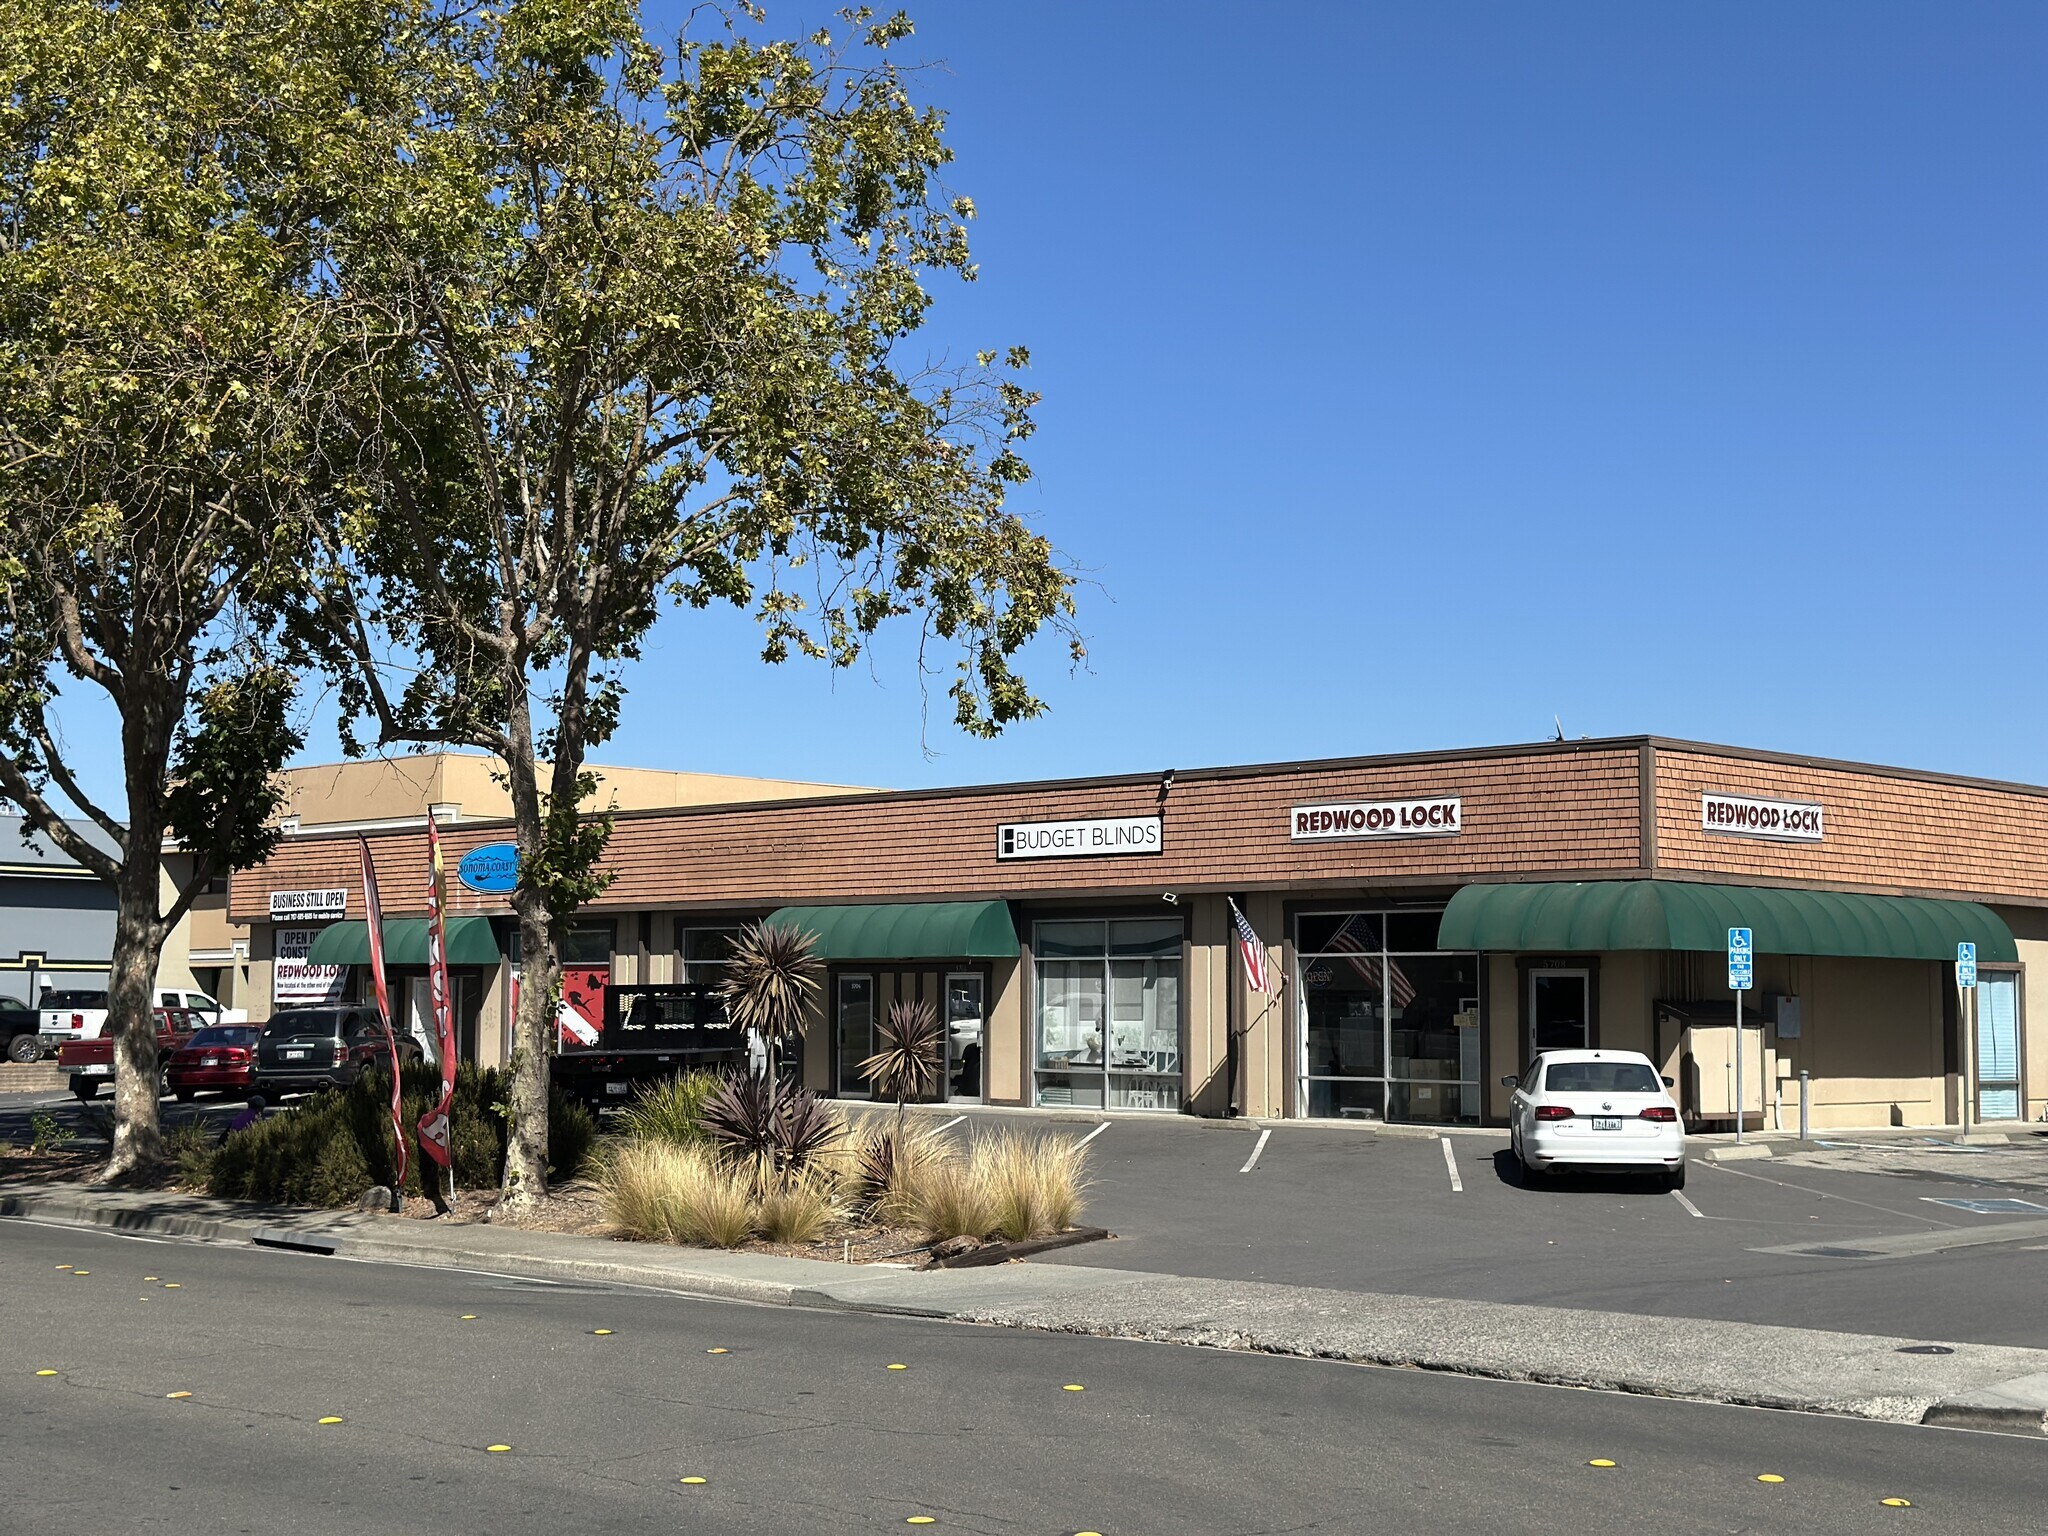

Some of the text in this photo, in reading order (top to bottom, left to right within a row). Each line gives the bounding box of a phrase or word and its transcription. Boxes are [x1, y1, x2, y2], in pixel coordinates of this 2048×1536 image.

[1296, 804, 1457, 834] REDWOOD LOCK
[1707, 801, 1820, 832] REDWOOD LOCK
[1016, 825, 1157, 849] BUDGET BLINDS
[459, 861, 513, 873] SONOMA COAST
[273, 891, 345, 909] BUSINESS STILL OPEN
[284, 931, 308, 945] OPEN
[280, 946, 311, 960] CONST
[277, 964, 322, 978] REDWOOD
